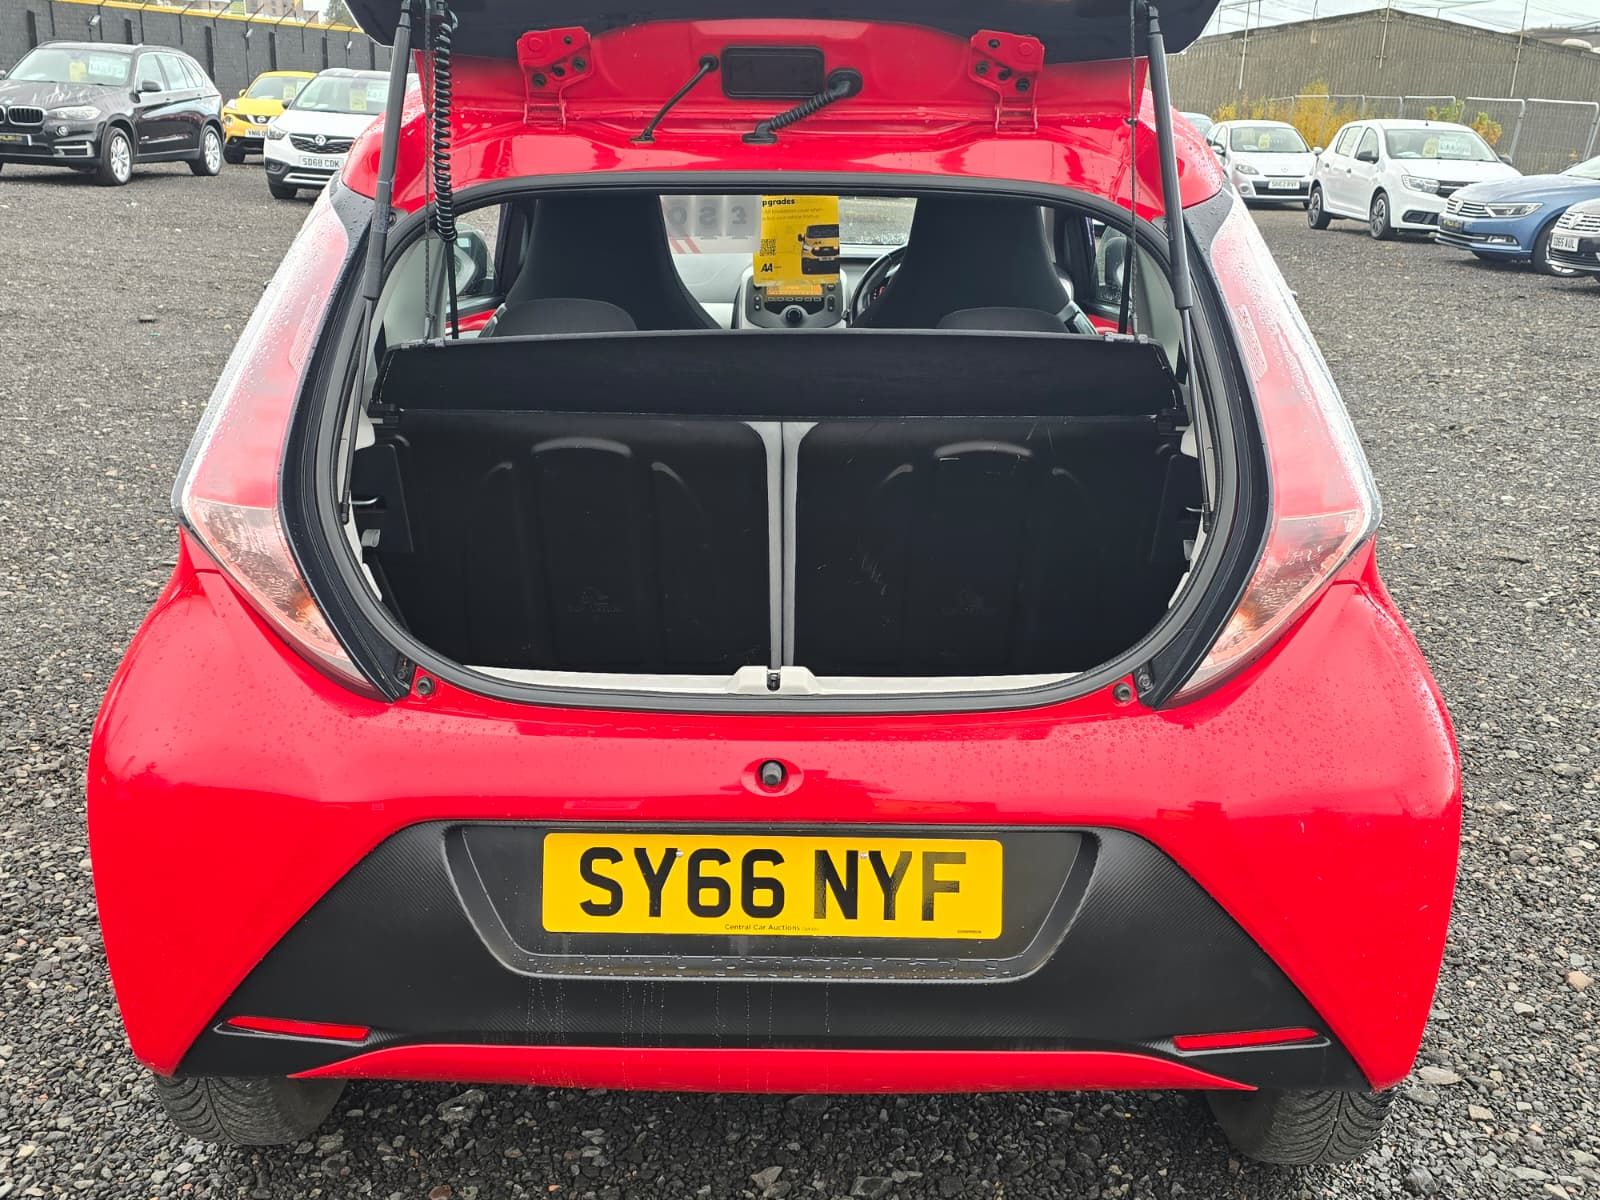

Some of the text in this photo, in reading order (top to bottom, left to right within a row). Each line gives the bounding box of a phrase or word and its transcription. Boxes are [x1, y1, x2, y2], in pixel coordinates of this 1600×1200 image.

[760, 263, 773, 273] AA
[579, 846, 966, 921] SY66 NYF
[725, 923, 751, 931] Central
[768, 924, 800, 932] Auctions
